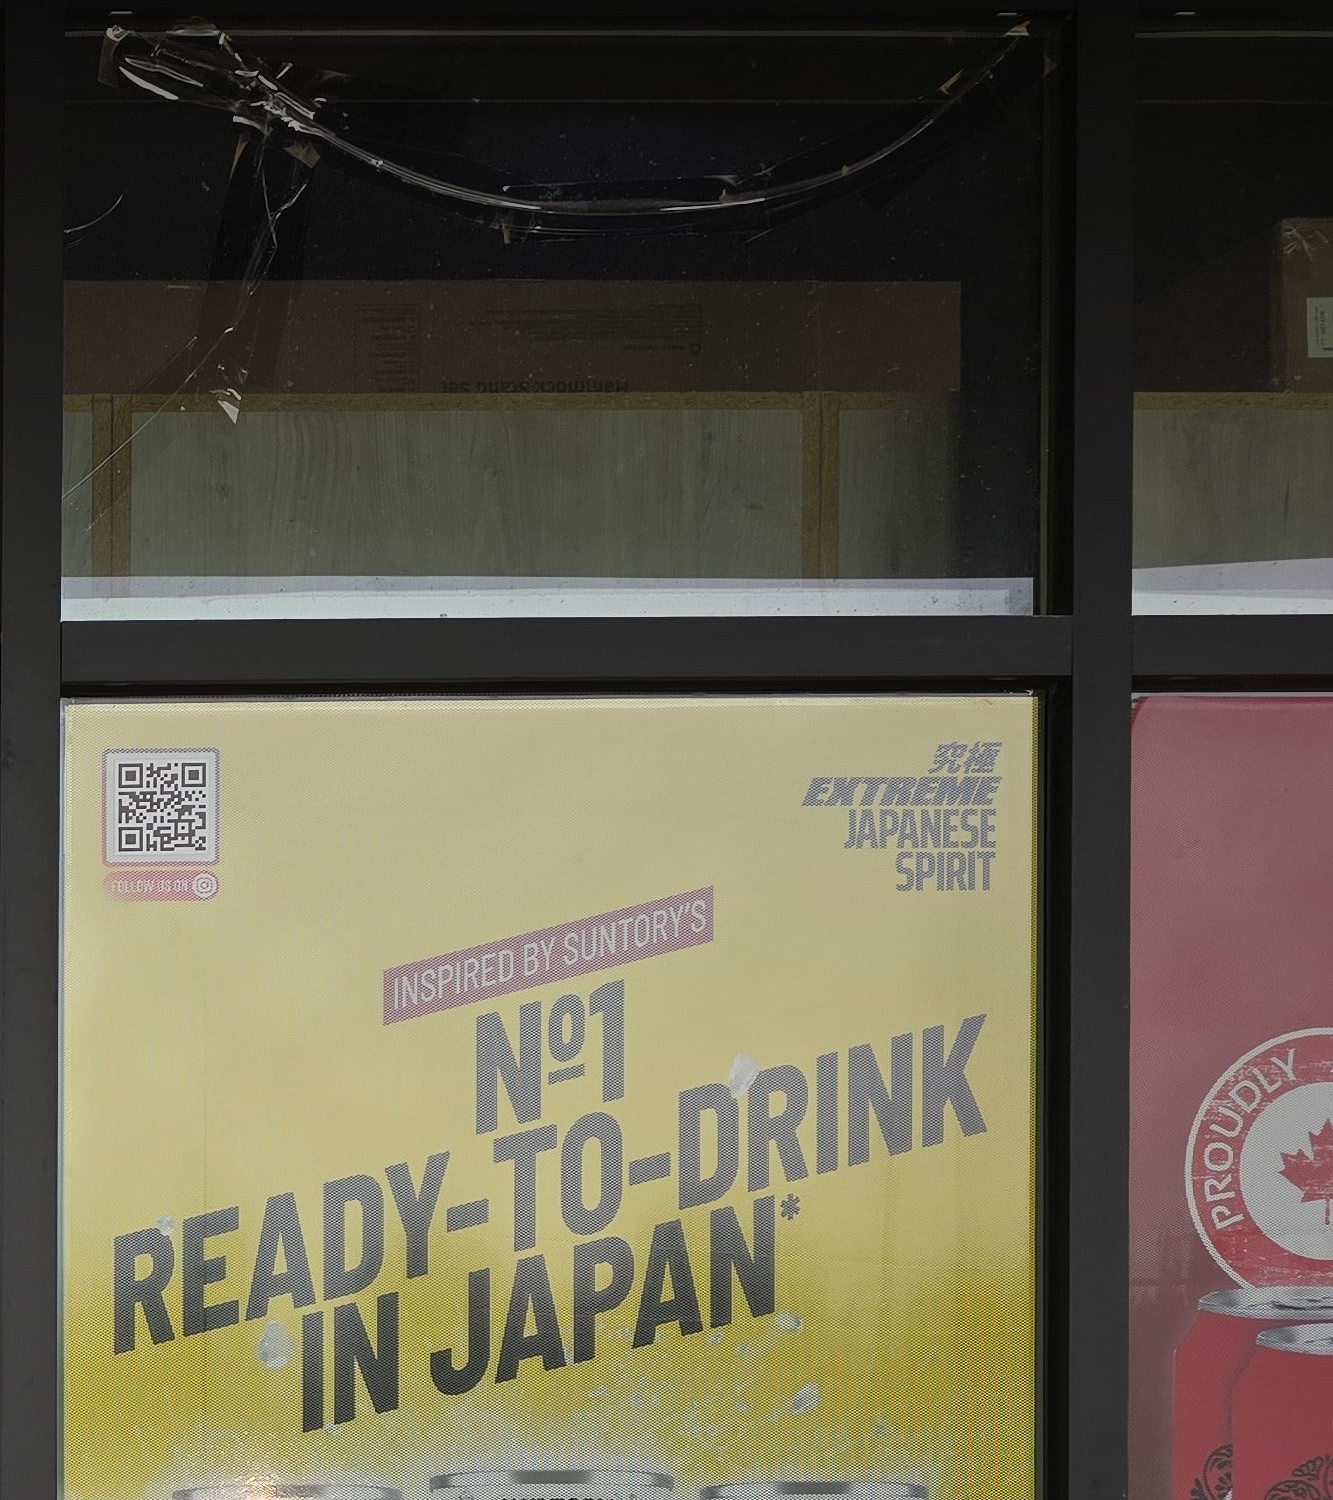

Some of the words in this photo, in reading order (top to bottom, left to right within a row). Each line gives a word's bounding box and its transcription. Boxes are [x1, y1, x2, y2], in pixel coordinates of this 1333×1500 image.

[801, 776, 1003, 807] EXTREME
[843, 808, 997, 850] JAPANESE
[895, 851, 997, 891] SPIRIT
[393, 948, 515, 1012] INSPIRED
[522, 938, 556, 978] BY
[563, 899, 708, 966] SUNTORY'S
[112, 1014, 989, 1356] READY-TO-DRINK
[1203, 1047, 1297, 1231] PROUDLY
[301, 1291, 401, 1435] IN
